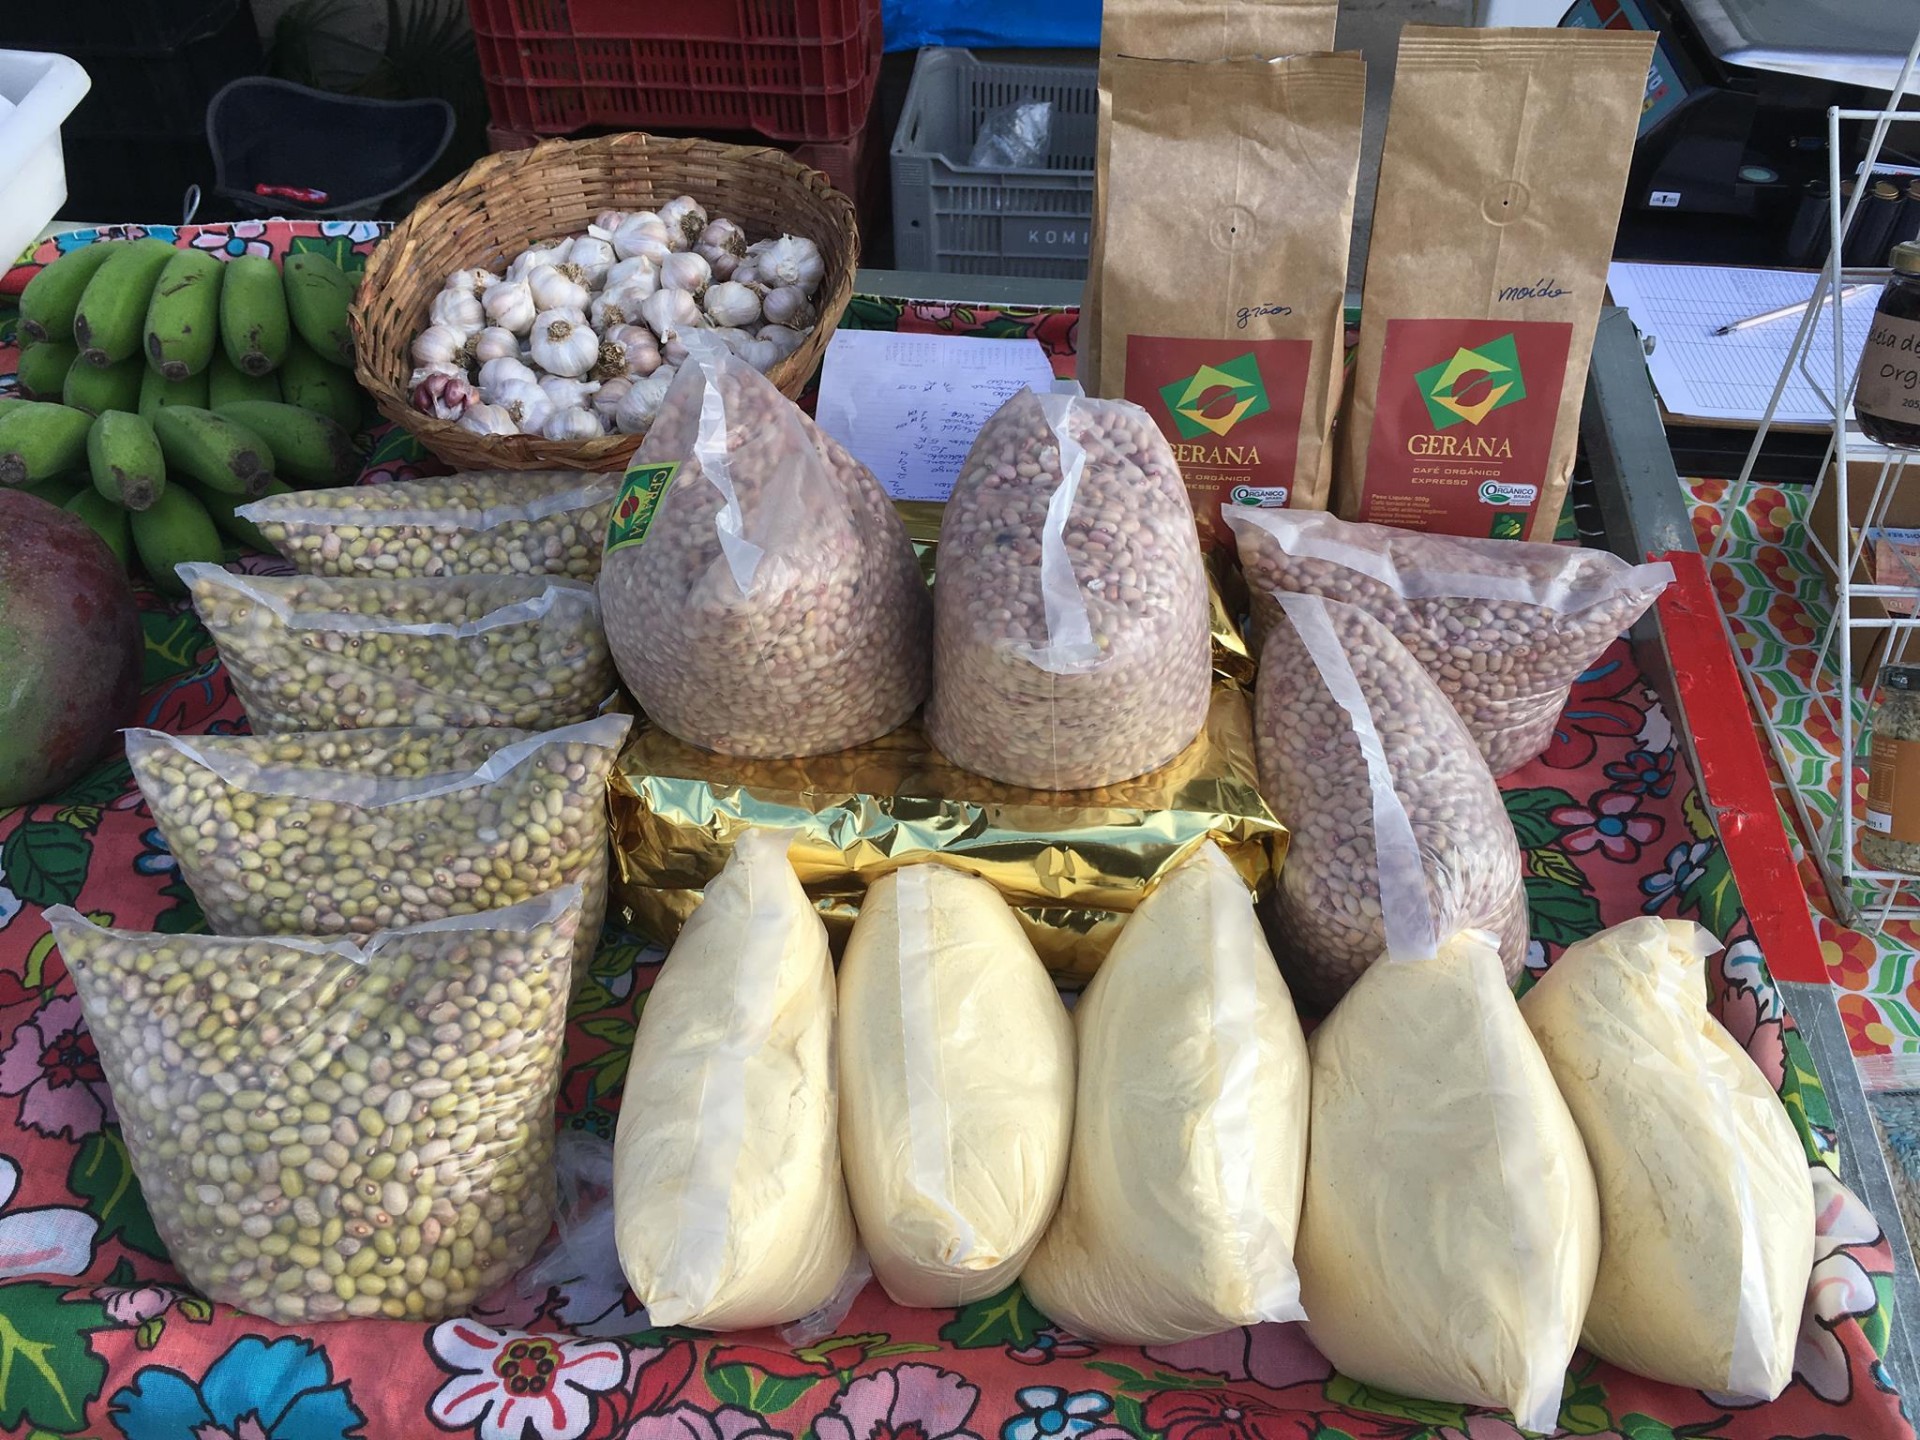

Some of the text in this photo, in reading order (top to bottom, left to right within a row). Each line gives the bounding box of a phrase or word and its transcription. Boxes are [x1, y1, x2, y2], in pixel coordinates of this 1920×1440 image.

[1498, 278, 1572, 302] moído
[1236, 302, 1292, 329] grãos
[1880, 363, 1920, 390] Org
[1407, 434, 1513, 458] GERANA
[1195, 474, 1251, 482] ORGÂNICO
[1411, 477, 1469, 486] EXPRESSO
[1412, 465, 1500, 477] CAFÉ ORGÂNICO
[1486, 484, 1534, 495] ORGÂNICO
[629, 470, 668, 537] GERANA
